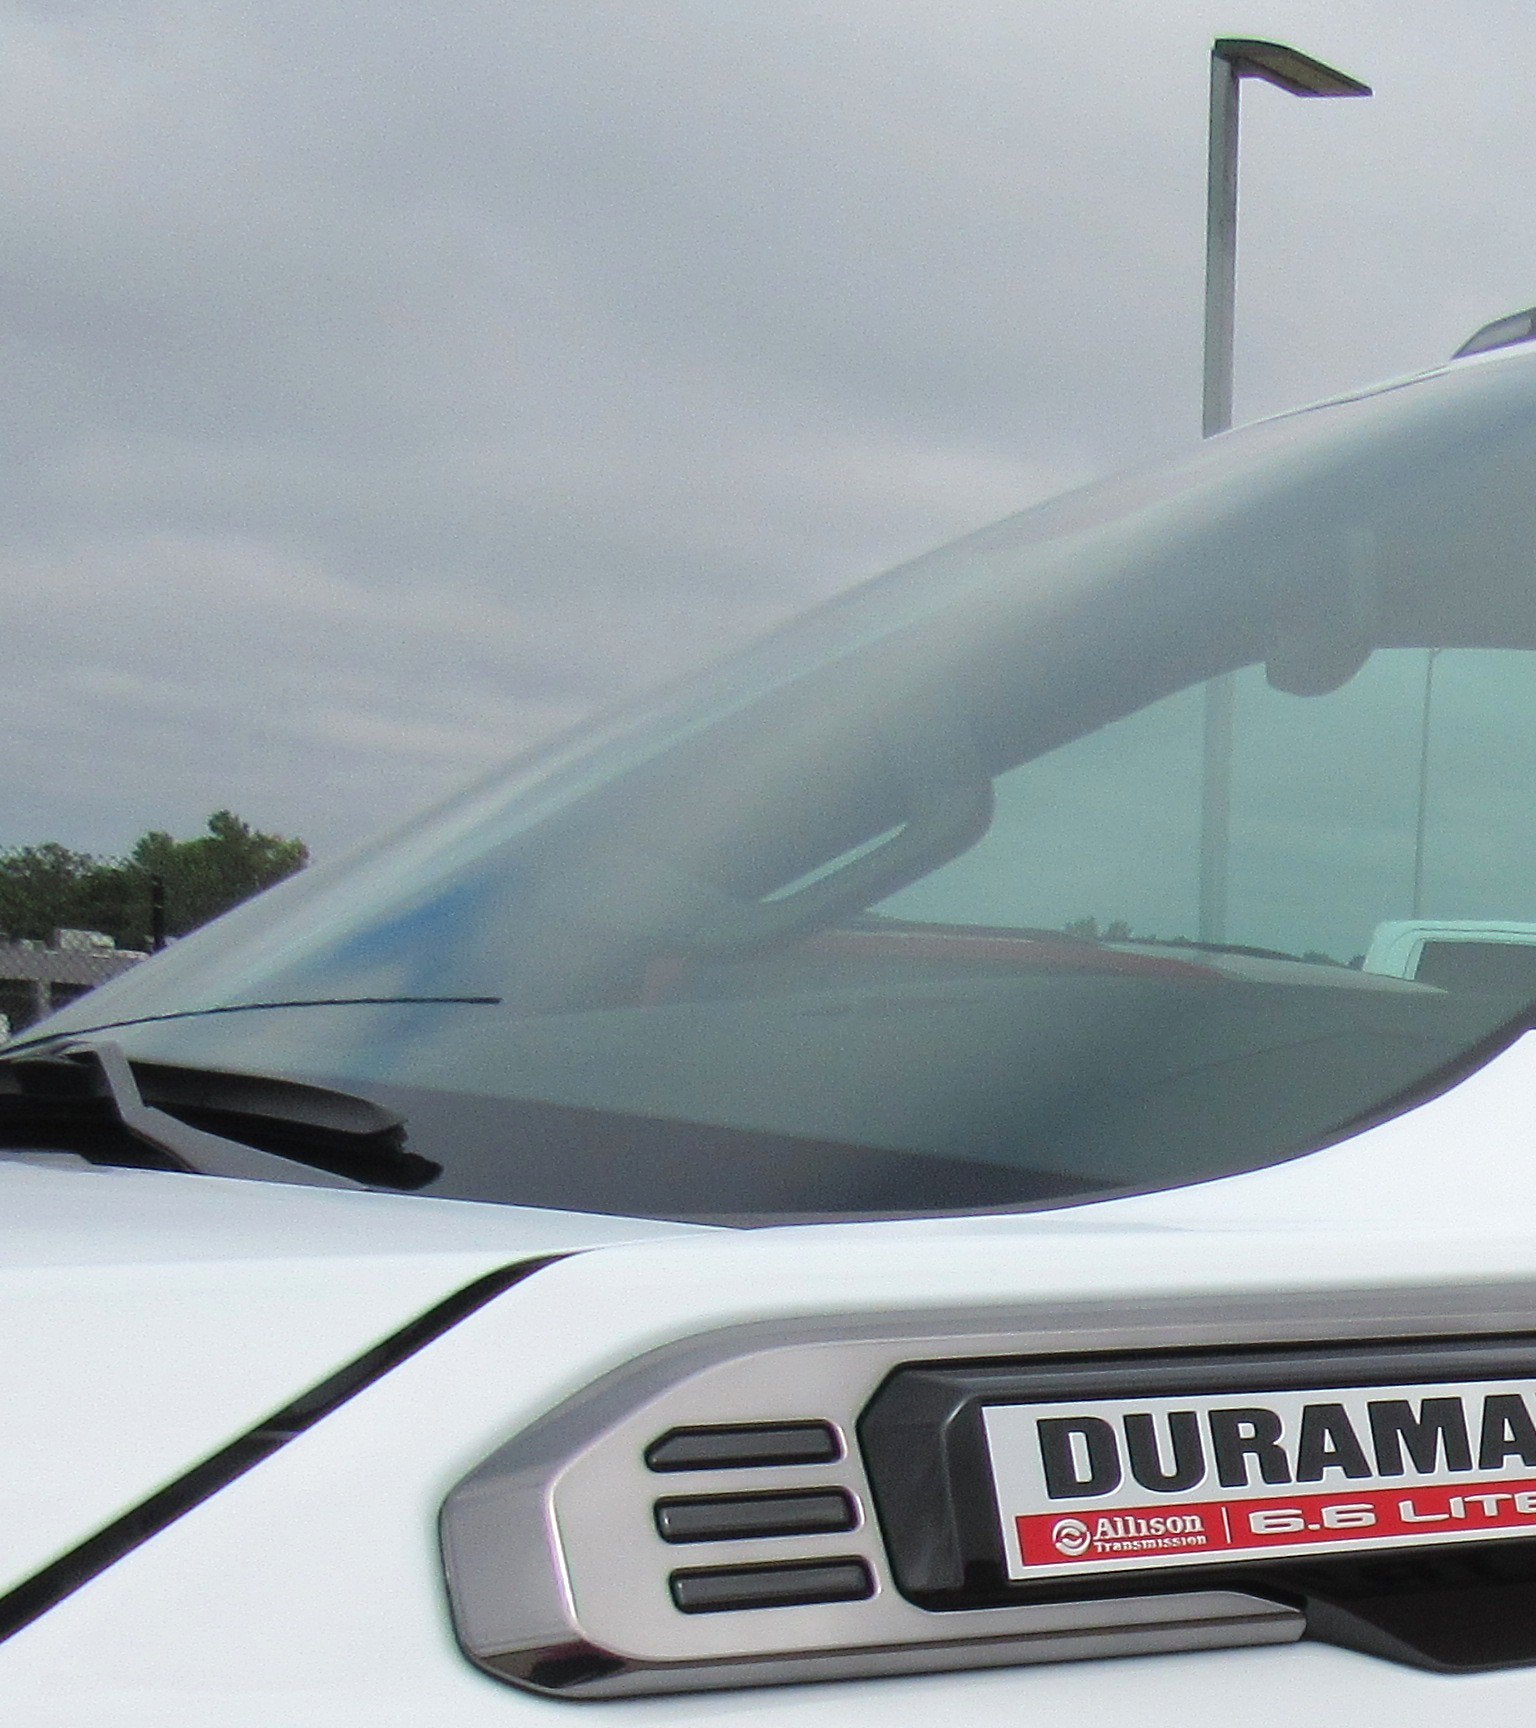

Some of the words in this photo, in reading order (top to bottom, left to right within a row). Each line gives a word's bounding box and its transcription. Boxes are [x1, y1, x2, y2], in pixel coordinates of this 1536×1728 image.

[1092, 1513, 1205, 1541] Allison
[1247, 1502, 1377, 1535] 6.6
[1092, 1533, 1208, 1554] Transmission
